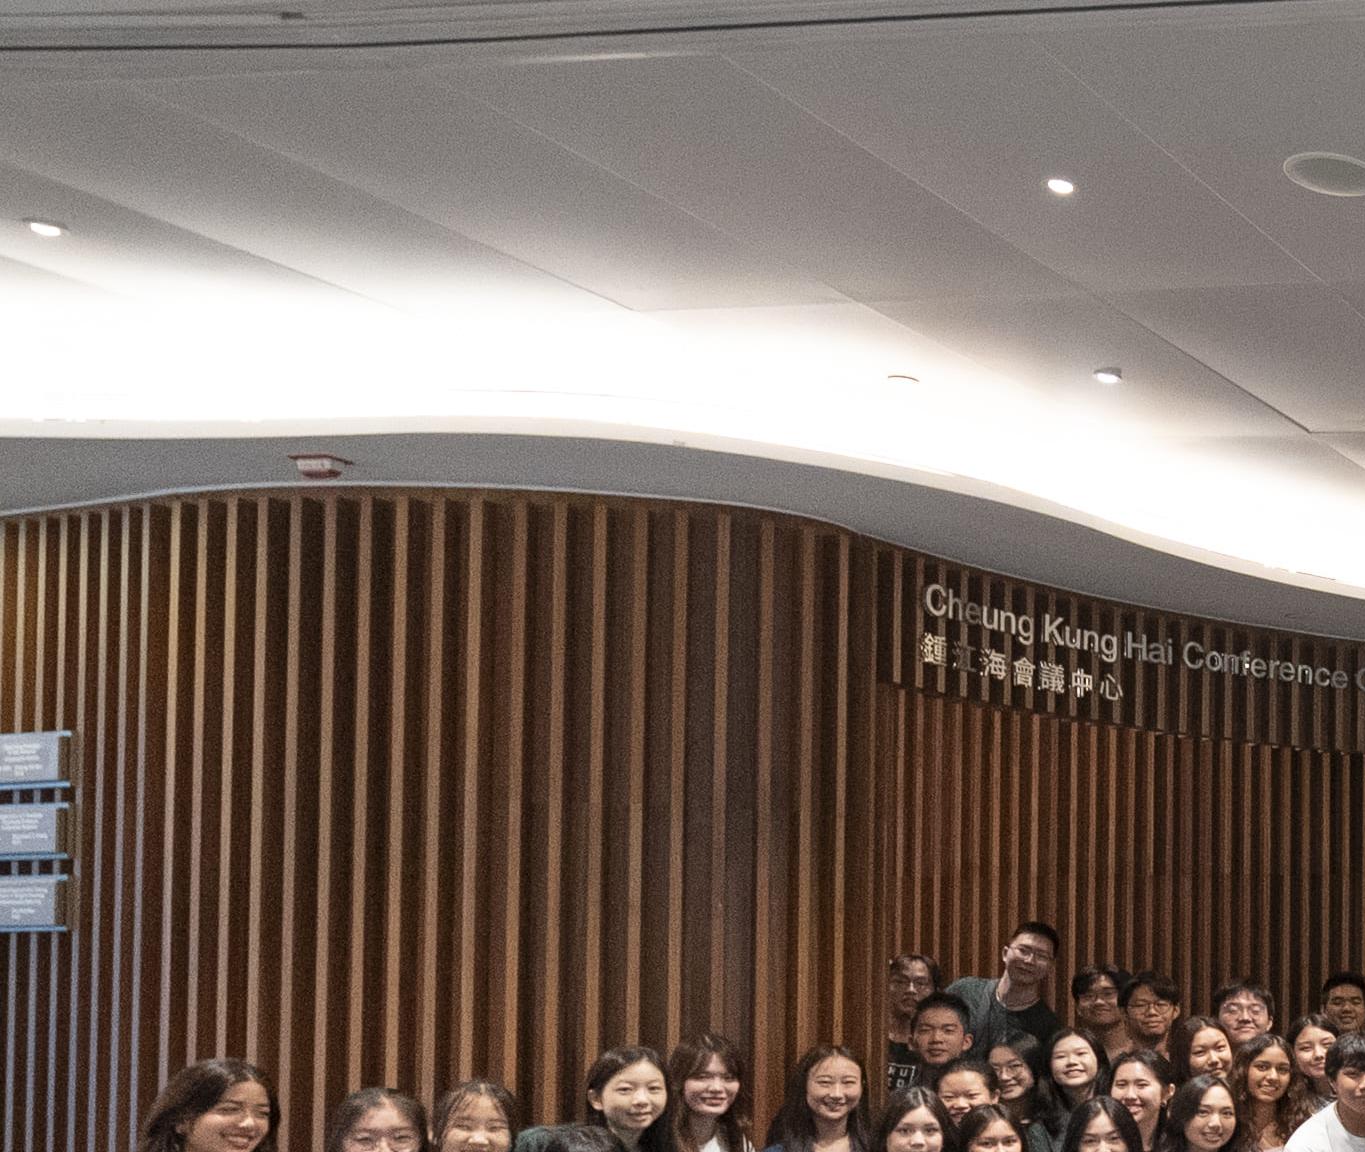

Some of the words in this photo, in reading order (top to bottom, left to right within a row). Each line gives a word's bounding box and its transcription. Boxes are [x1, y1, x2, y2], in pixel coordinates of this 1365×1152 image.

[925, 583, 1034, 646] Cheung
[1043, 613, 1118, 663] Kung
[1126, 631, 1174, 665] Hai
[1182, 641, 1349, 689] Conference
